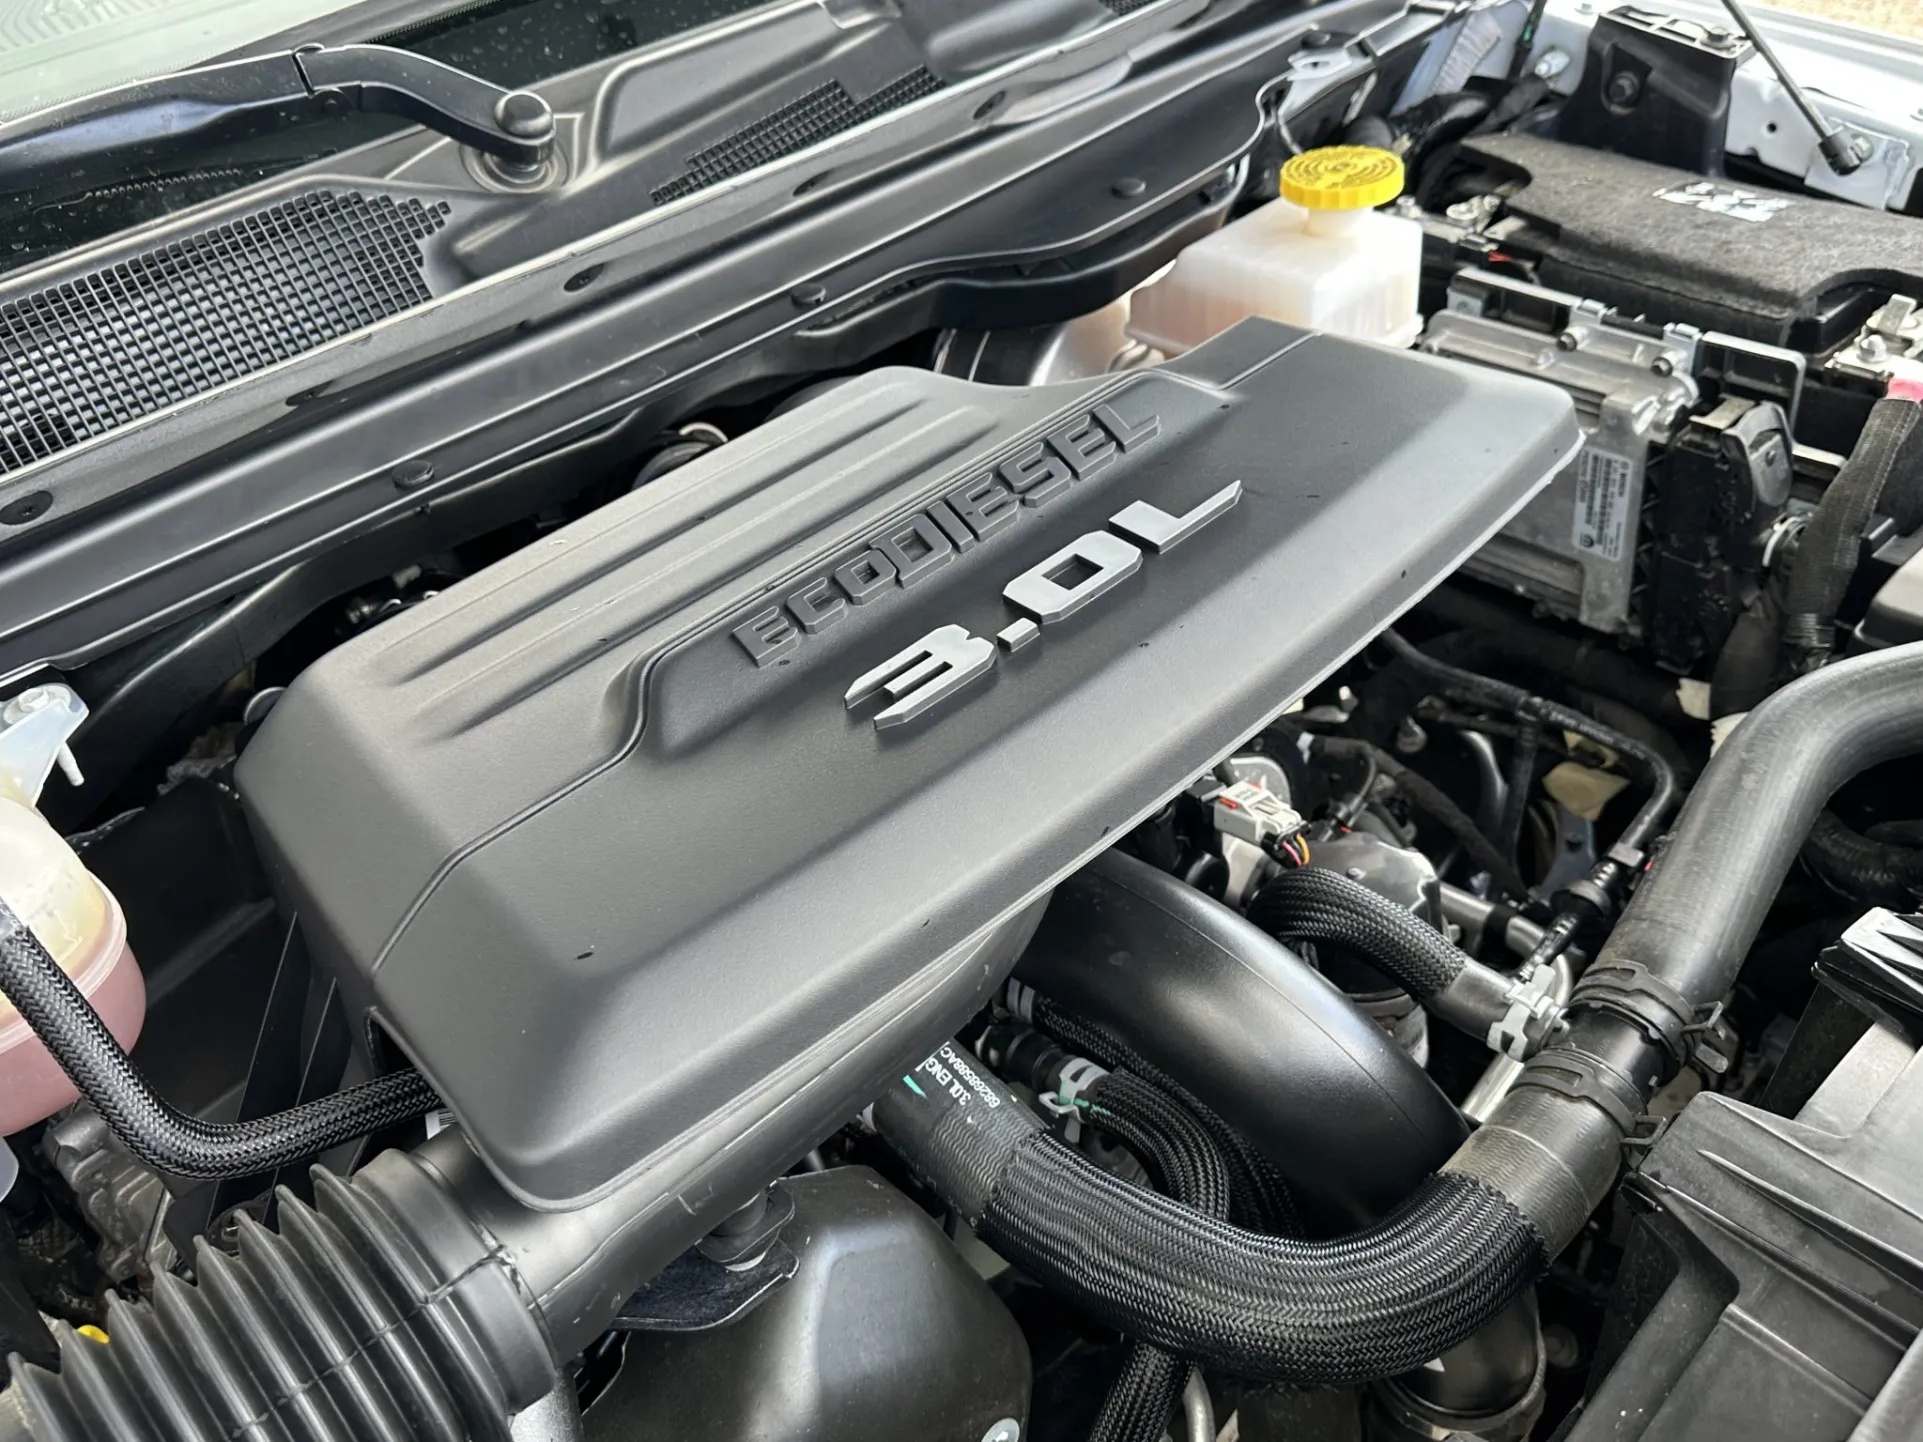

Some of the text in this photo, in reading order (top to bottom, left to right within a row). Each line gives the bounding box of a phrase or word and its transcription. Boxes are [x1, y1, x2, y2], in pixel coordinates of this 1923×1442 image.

[730, 404, 1161, 668] ECODIESEL
[844, 479, 1243, 731] 3.0L
[925, 1057, 971, 1105] 3.0L ENG
[940, 1046, 1000, 1108] 68268588AC
